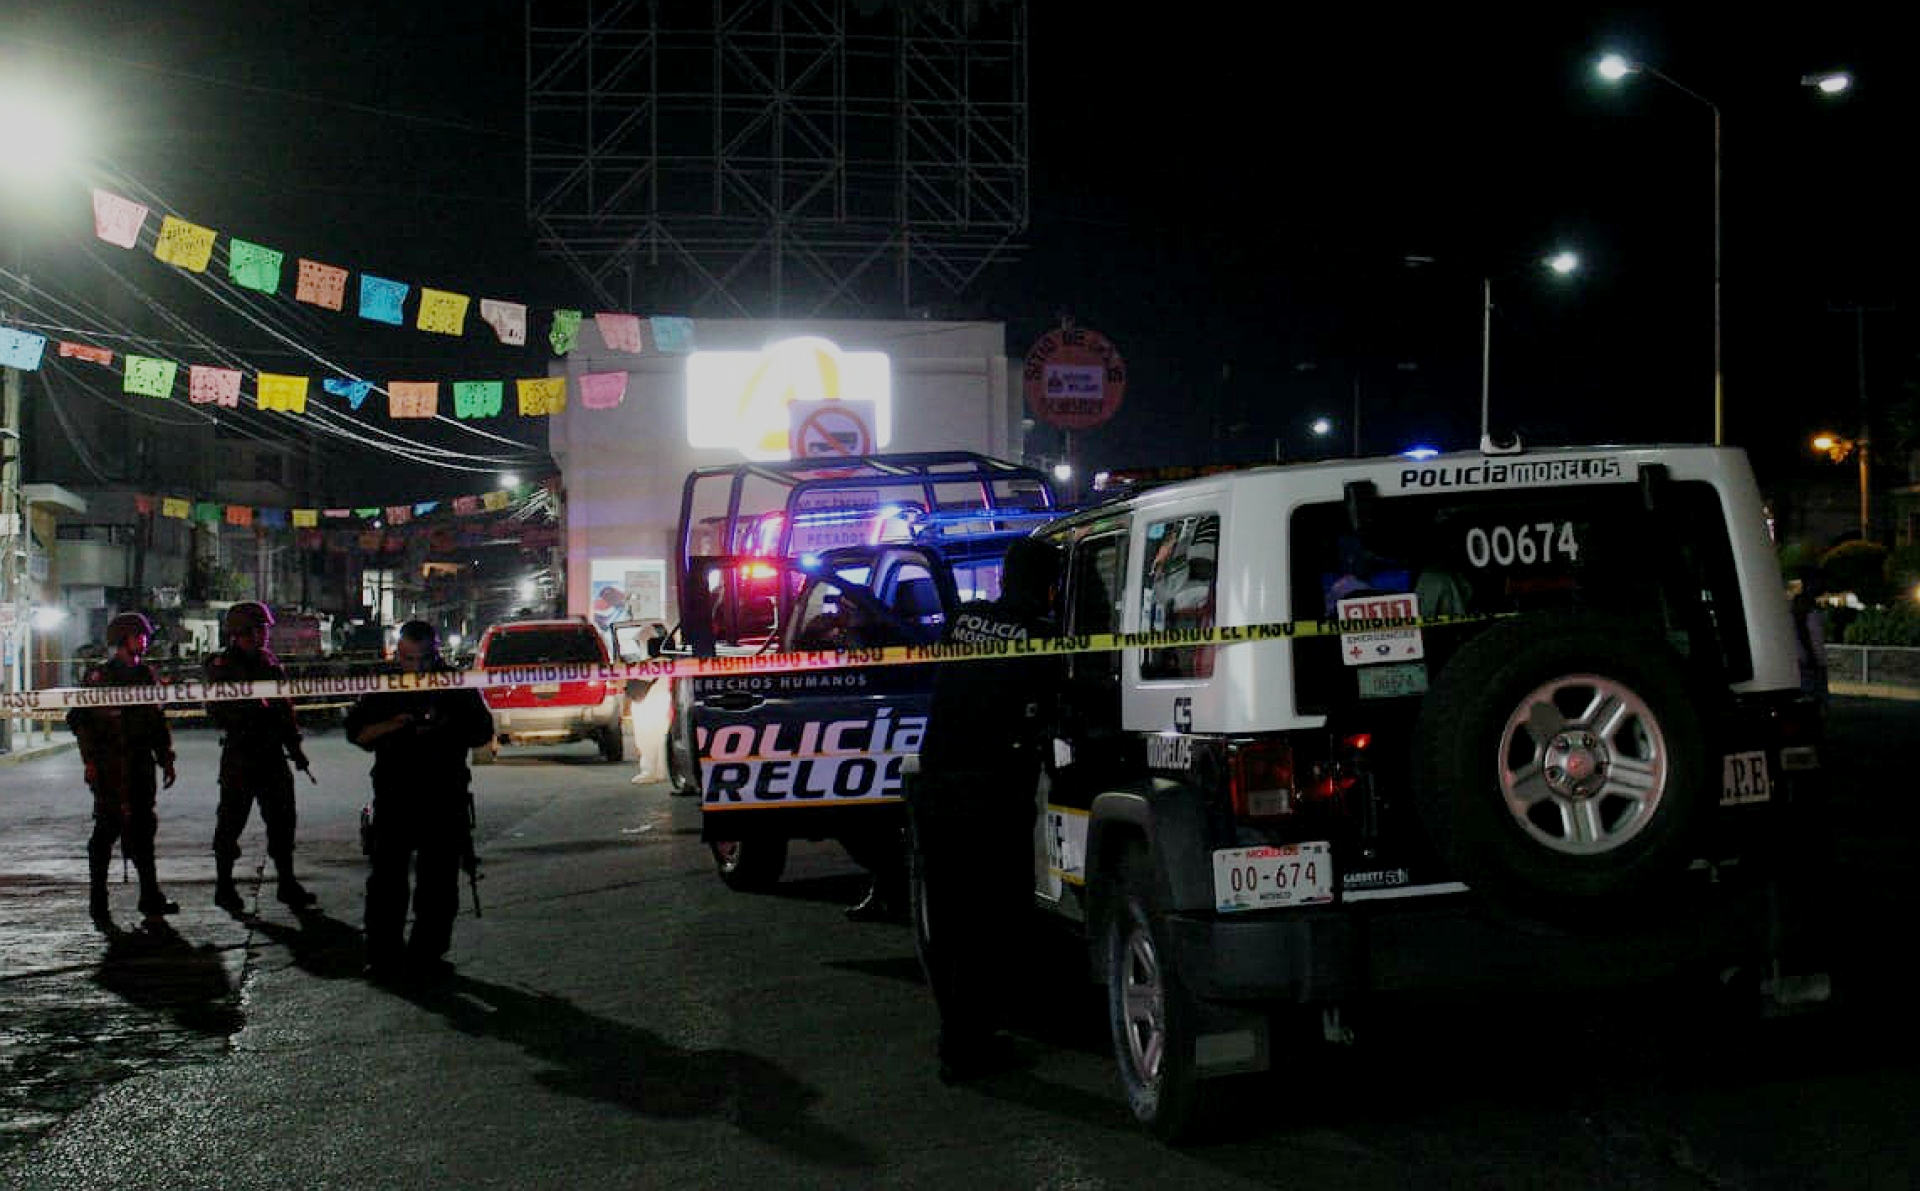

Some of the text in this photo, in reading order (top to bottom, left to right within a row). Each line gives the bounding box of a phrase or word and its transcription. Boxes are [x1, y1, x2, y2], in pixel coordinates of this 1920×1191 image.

[1511, 457, 1621, 483] MORELOS
[1466, 521, 1578, 568] 00674
[62, 683, 168, 706] PROHIBIDO
[174, 680, 197, 700] EL
[201, 679, 254, 699] PASO
[276, 674, 381, 695] PROHIBIDO
[388, 672, 409, 690] EL
[415, 670, 465, 688] PASO
[486, 664, 591, 684] PROHIBIDO
[598, 662, 620, 679] EL
[626, 659, 676, 676] PASO
[698, 652, 801, 671] PROHIBIDO
[807, 650, 829, 666] EL
[835, 647, 884, 665] PASO
[906, 638, 1008, 659] PROHIBIDO
[1015, 636, 1036, 654] EL
[1041, 633, 1090, 651] PASO
[1221, 625, 1241, 641] EL
[1247, 622, 1295, 639] PASO
[780, 673, 868, 689] HUMANOS
[697, 707, 928, 759] OLICía
[1231, 861, 1317, 891] 00-674
